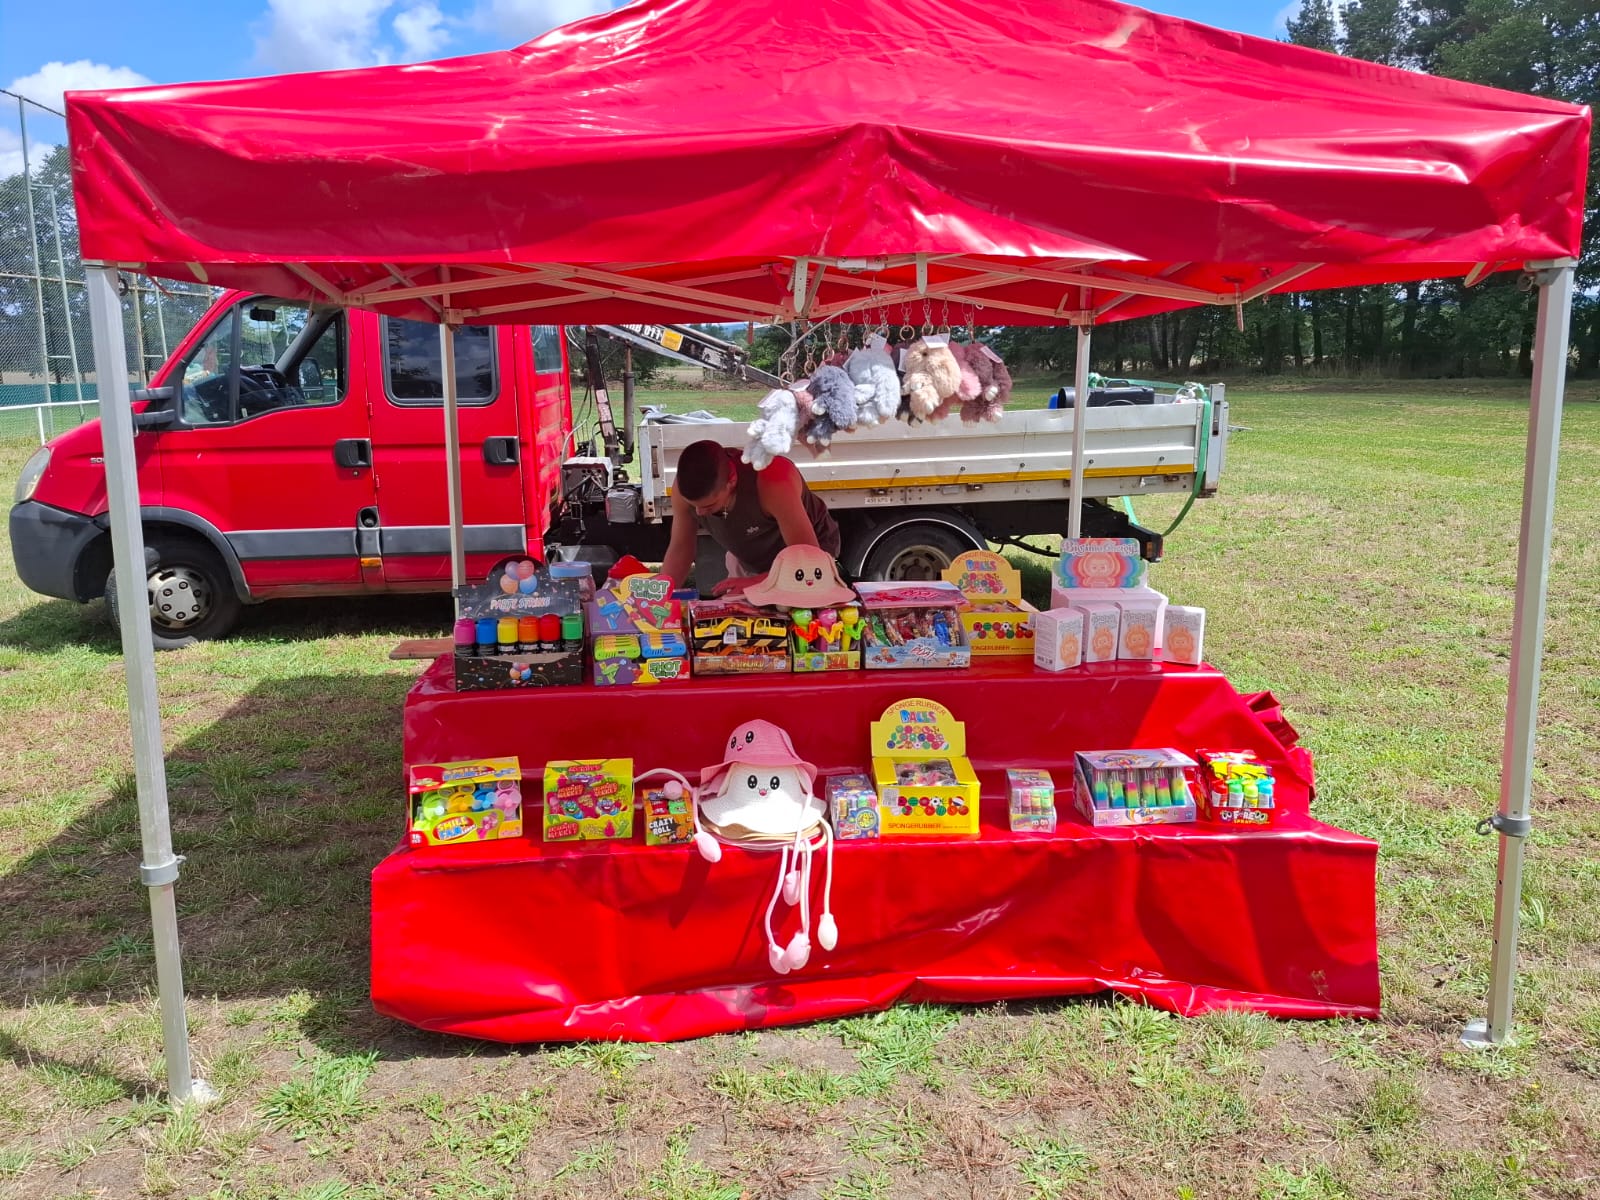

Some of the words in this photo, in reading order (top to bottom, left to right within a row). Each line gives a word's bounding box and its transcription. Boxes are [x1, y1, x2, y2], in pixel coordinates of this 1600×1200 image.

[630, 578, 669, 593] SHOT
[650, 660, 681, 673] SHOT
[900, 709, 937, 723] BALLS
[437, 816, 467, 831] SMILE
[648, 817, 674, 829] CRAZY
[653, 825, 671, 836] ROLL
